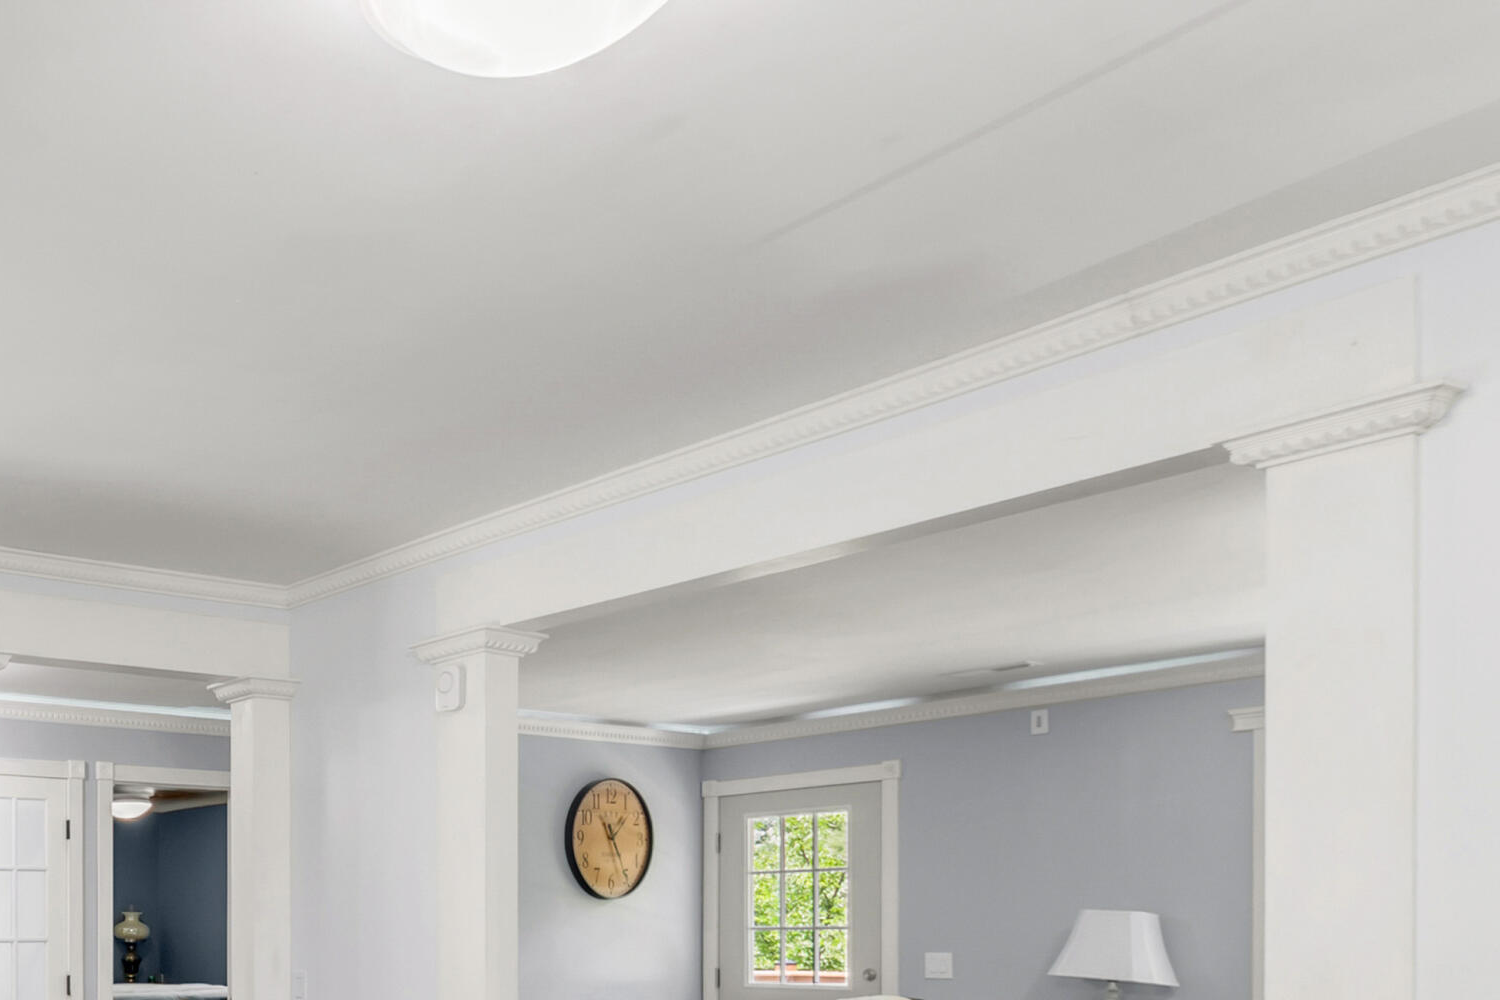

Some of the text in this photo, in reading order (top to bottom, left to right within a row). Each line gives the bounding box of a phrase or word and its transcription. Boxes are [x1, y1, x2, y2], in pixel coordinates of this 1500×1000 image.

[592, 793, 600, 809] 11
[605, 788, 617, 804] 12
[623, 794, 627, 810] 1
[581, 809, 592, 825] 10
[632, 811, 639, 826] 2
[576, 830, 585, 846] 9
[581, 852, 589, 869] 8
[593, 867, 600, 884] 7
[608, 874, 615, 889] 6
